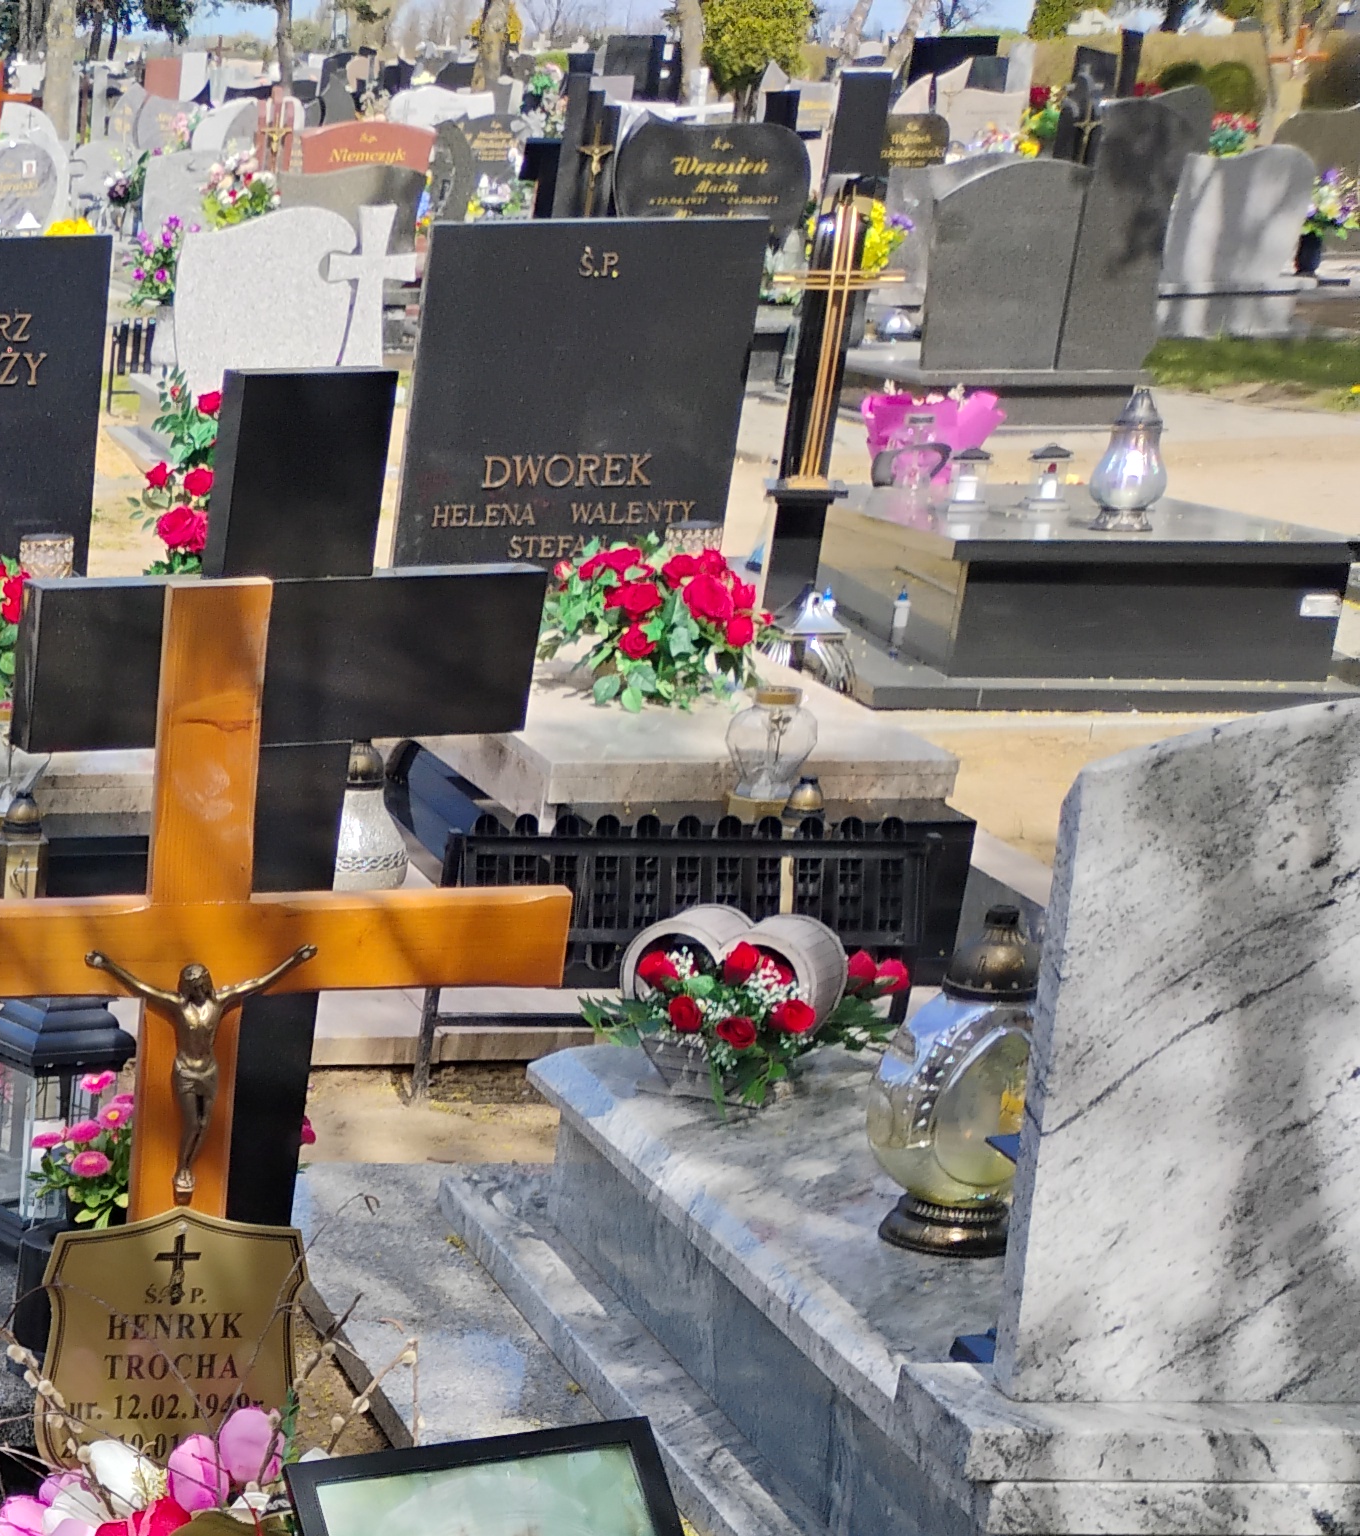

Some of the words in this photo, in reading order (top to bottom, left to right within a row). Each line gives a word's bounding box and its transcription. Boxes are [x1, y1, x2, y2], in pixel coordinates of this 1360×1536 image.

[329, 148, 406, 164] Niemczyk
[671, 156, 768, 175] Wrzesień
[693, 180, 738, 193] Maria
[580, 246, 620, 278] Ś.P.
[481, 453, 653, 489] DWOREK
[431, 503, 536, 528] HELENA
[572, 500, 697, 526] WALENTY
[106, 1312, 243, 1340] HENRYK
[104, 1354, 239, 1380] TROCHA
